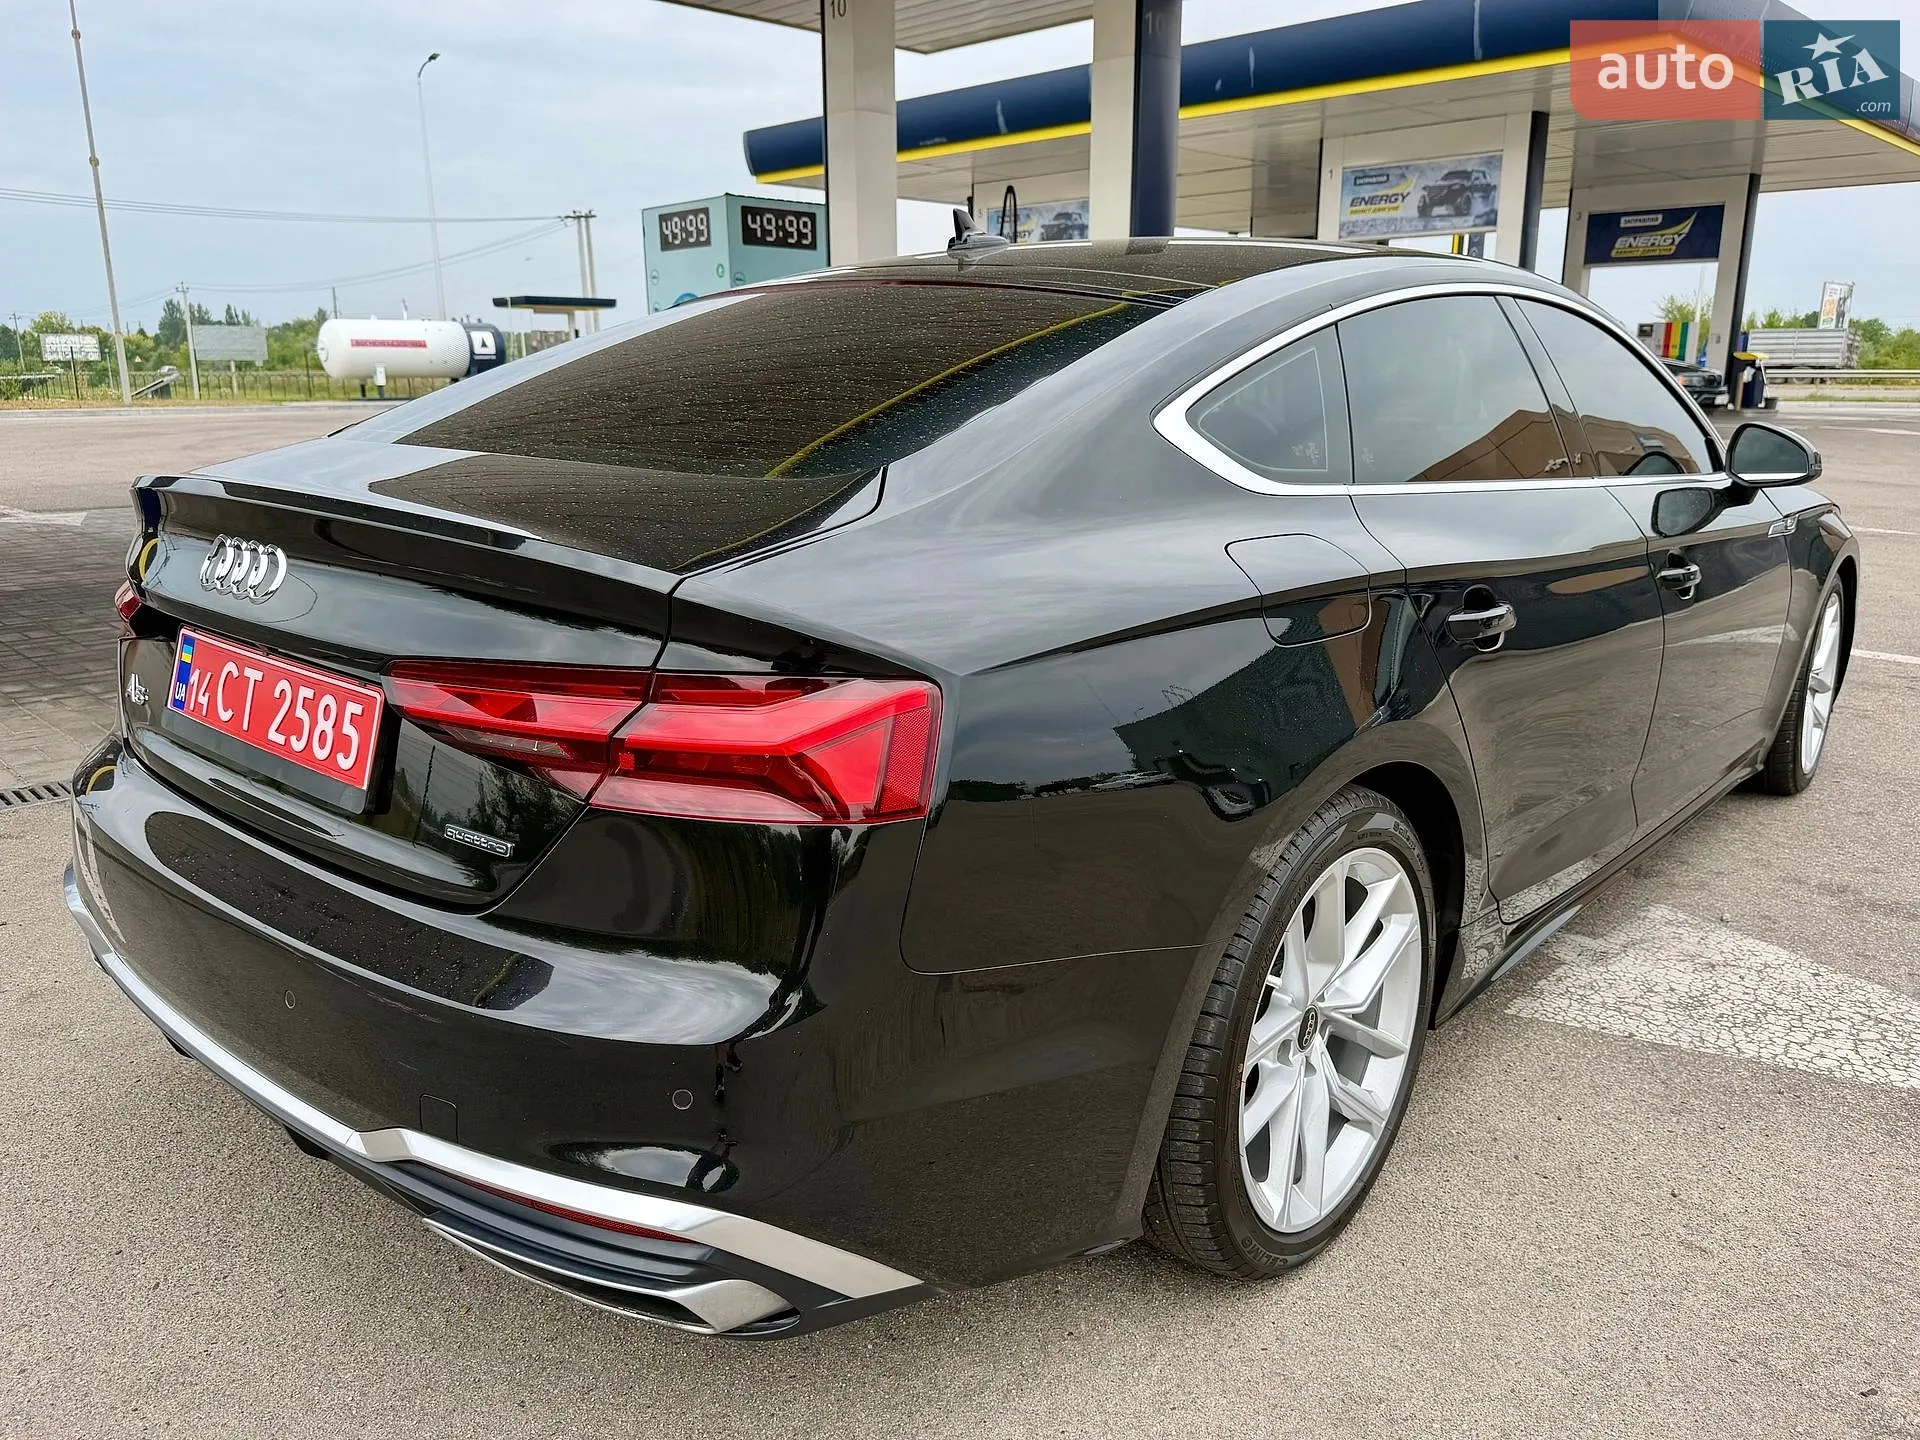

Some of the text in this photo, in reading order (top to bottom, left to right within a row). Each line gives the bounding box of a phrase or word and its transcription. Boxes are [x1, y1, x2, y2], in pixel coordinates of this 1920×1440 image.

[829, 0, 847, 19] 10
[1350, 192, 1410, 208] ENERGY
[661, 212, 708, 245] 49:99
[747, 212, 813, 245] 49:99
[1614, 233, 1687, 249] ENERGY
[175, 660, 364, 771] UA 14 CT 2585
[446, 827, 508, 854] quattro
